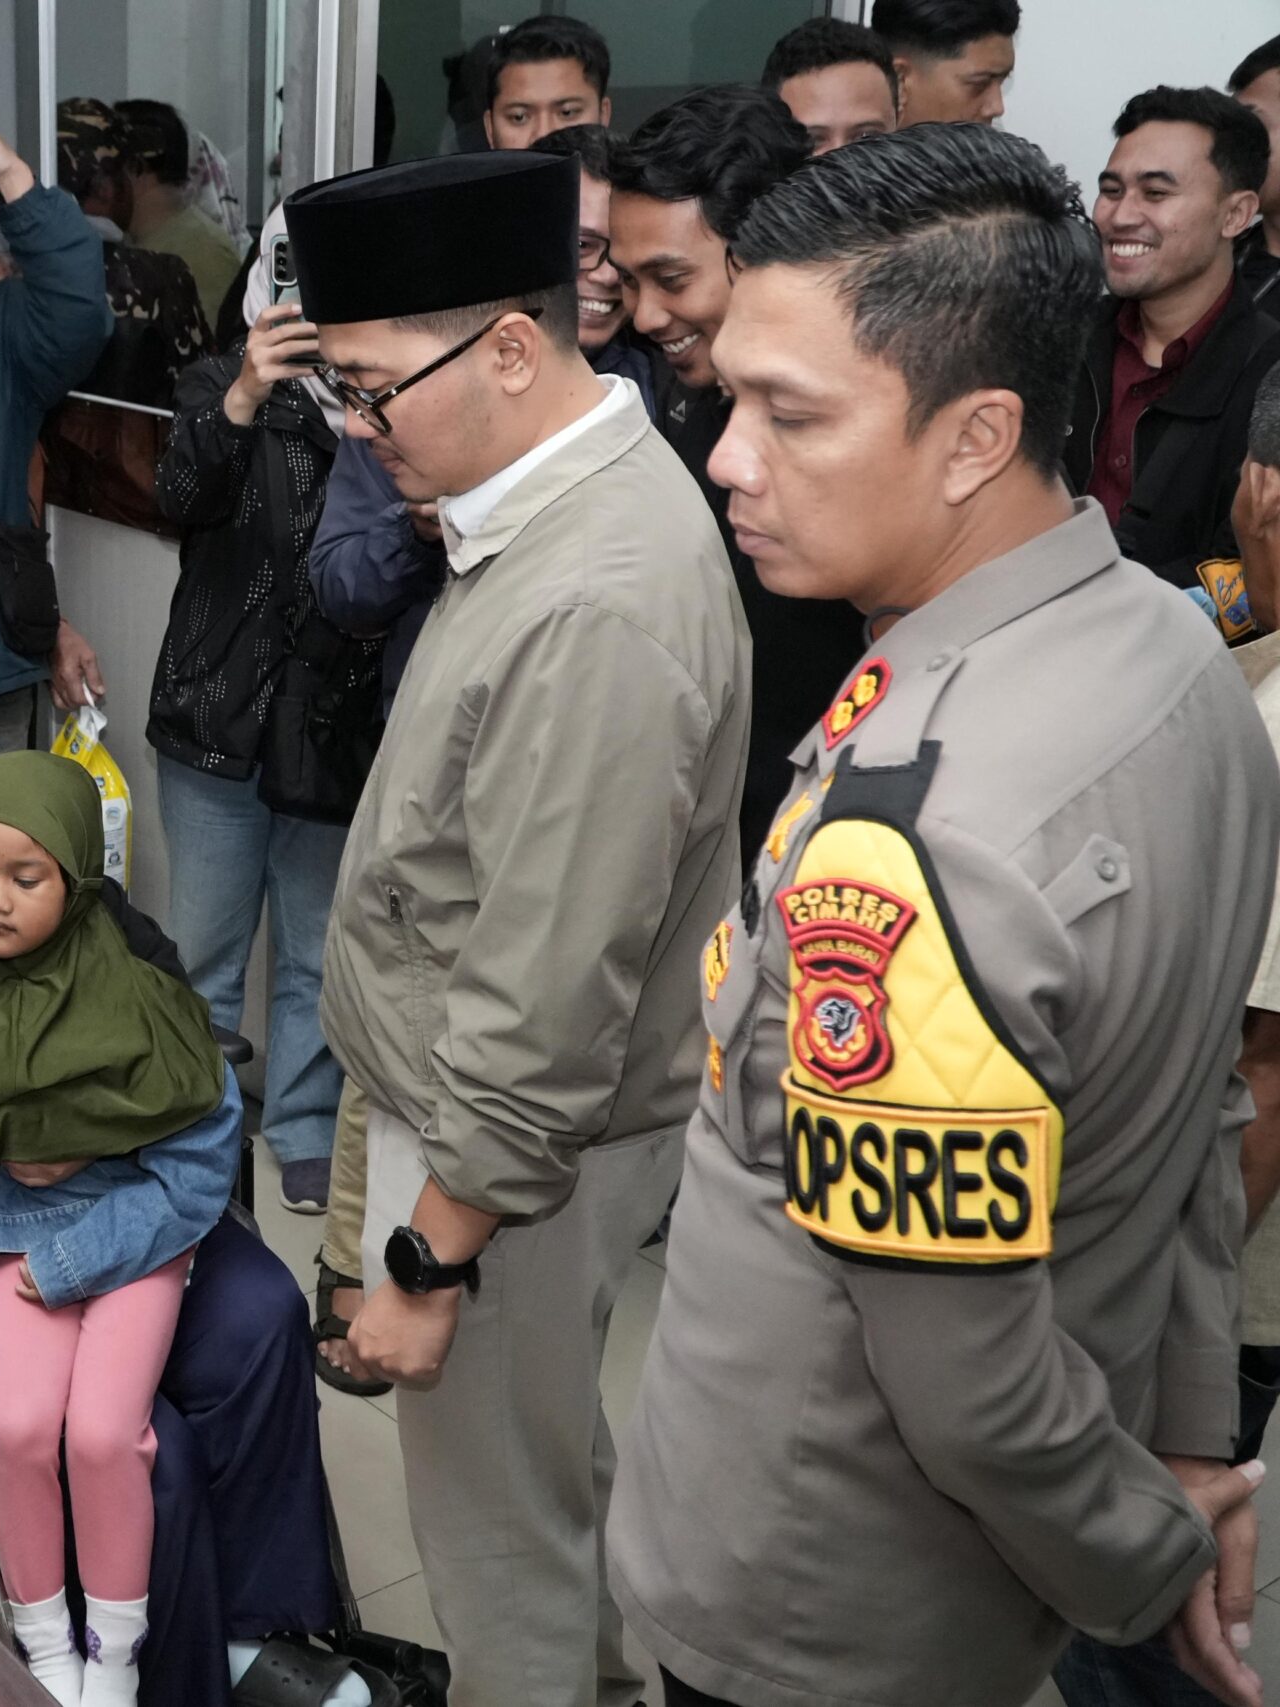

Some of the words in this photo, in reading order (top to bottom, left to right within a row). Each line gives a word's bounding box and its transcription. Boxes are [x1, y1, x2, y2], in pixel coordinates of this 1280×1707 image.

[785, 885, 900, 922] POLRES
[794, 902, 886, 934] CIMAHI
[786, 1107, 1032, 1241] OPSRES
